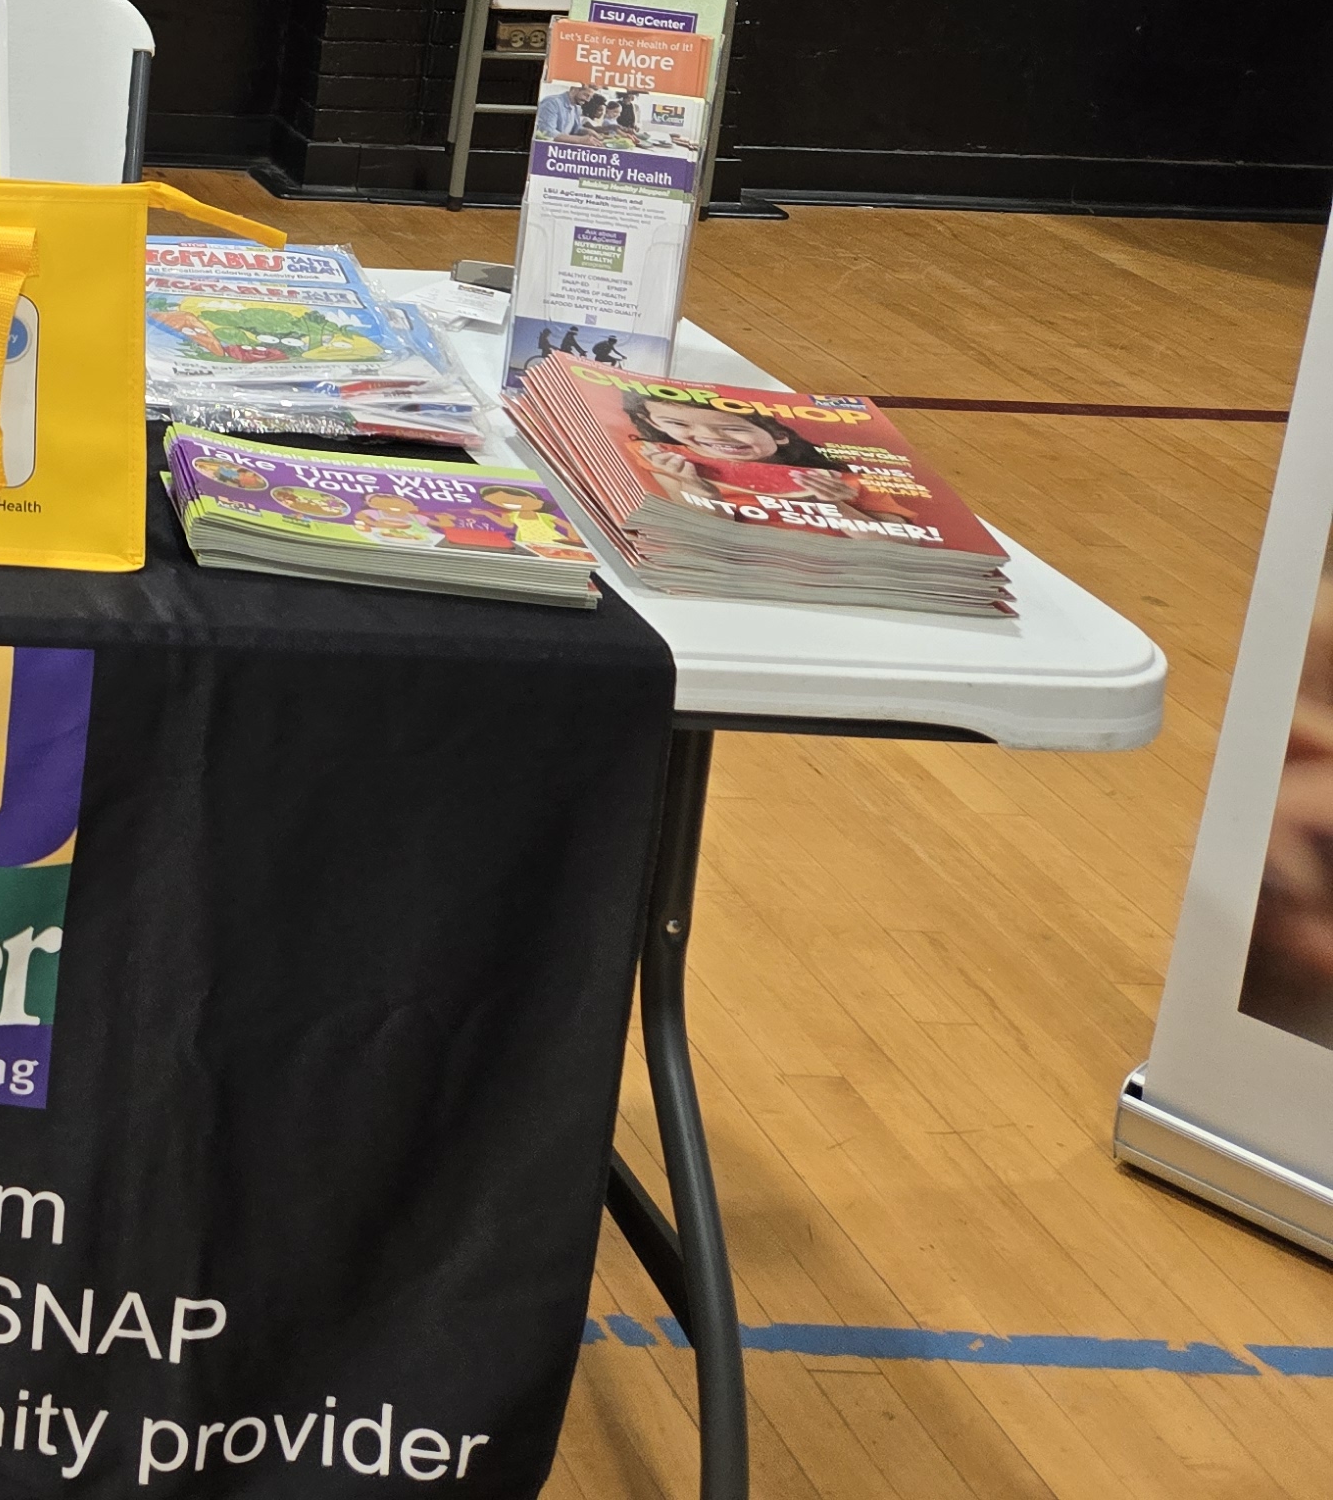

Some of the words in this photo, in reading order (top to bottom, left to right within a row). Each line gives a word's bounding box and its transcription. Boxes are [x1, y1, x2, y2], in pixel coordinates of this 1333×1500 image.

[600, 10, 624, 21] LSU
[627, 13, 685, 30] AgCenter
[576, 45, 611, 64] Eat
[617, 50, 674, 71] More
[591, 66, 655, 88] Fruits
[547, 146, 607, 164] Nutrition
[610, 154, 620, 166] &
[546, 160, 623, 181] Community
[627, 169, 672, 185] Health
[286, 256, 330, 268] TASTE
[287, 264, 340, 277] GREAT!
[570, 365, 721, 404] CHOP
[709, 398, 873, 425] CHOP
[192, 441, 276, 472] Take
[285, 462, 378, 483] Time
[385, 472, 477, 494] With
[847, 464, 915, 479] PLUS:
[295, 474, 381, 494] Your
[391, 485, 472, 504] Kids
[680, 491, 769, 520] INTO
[778, 511, 944, 542] SUMMER!
[754, 495, 843, 518] BITE
[138, 1396, 490, 1485] provider
